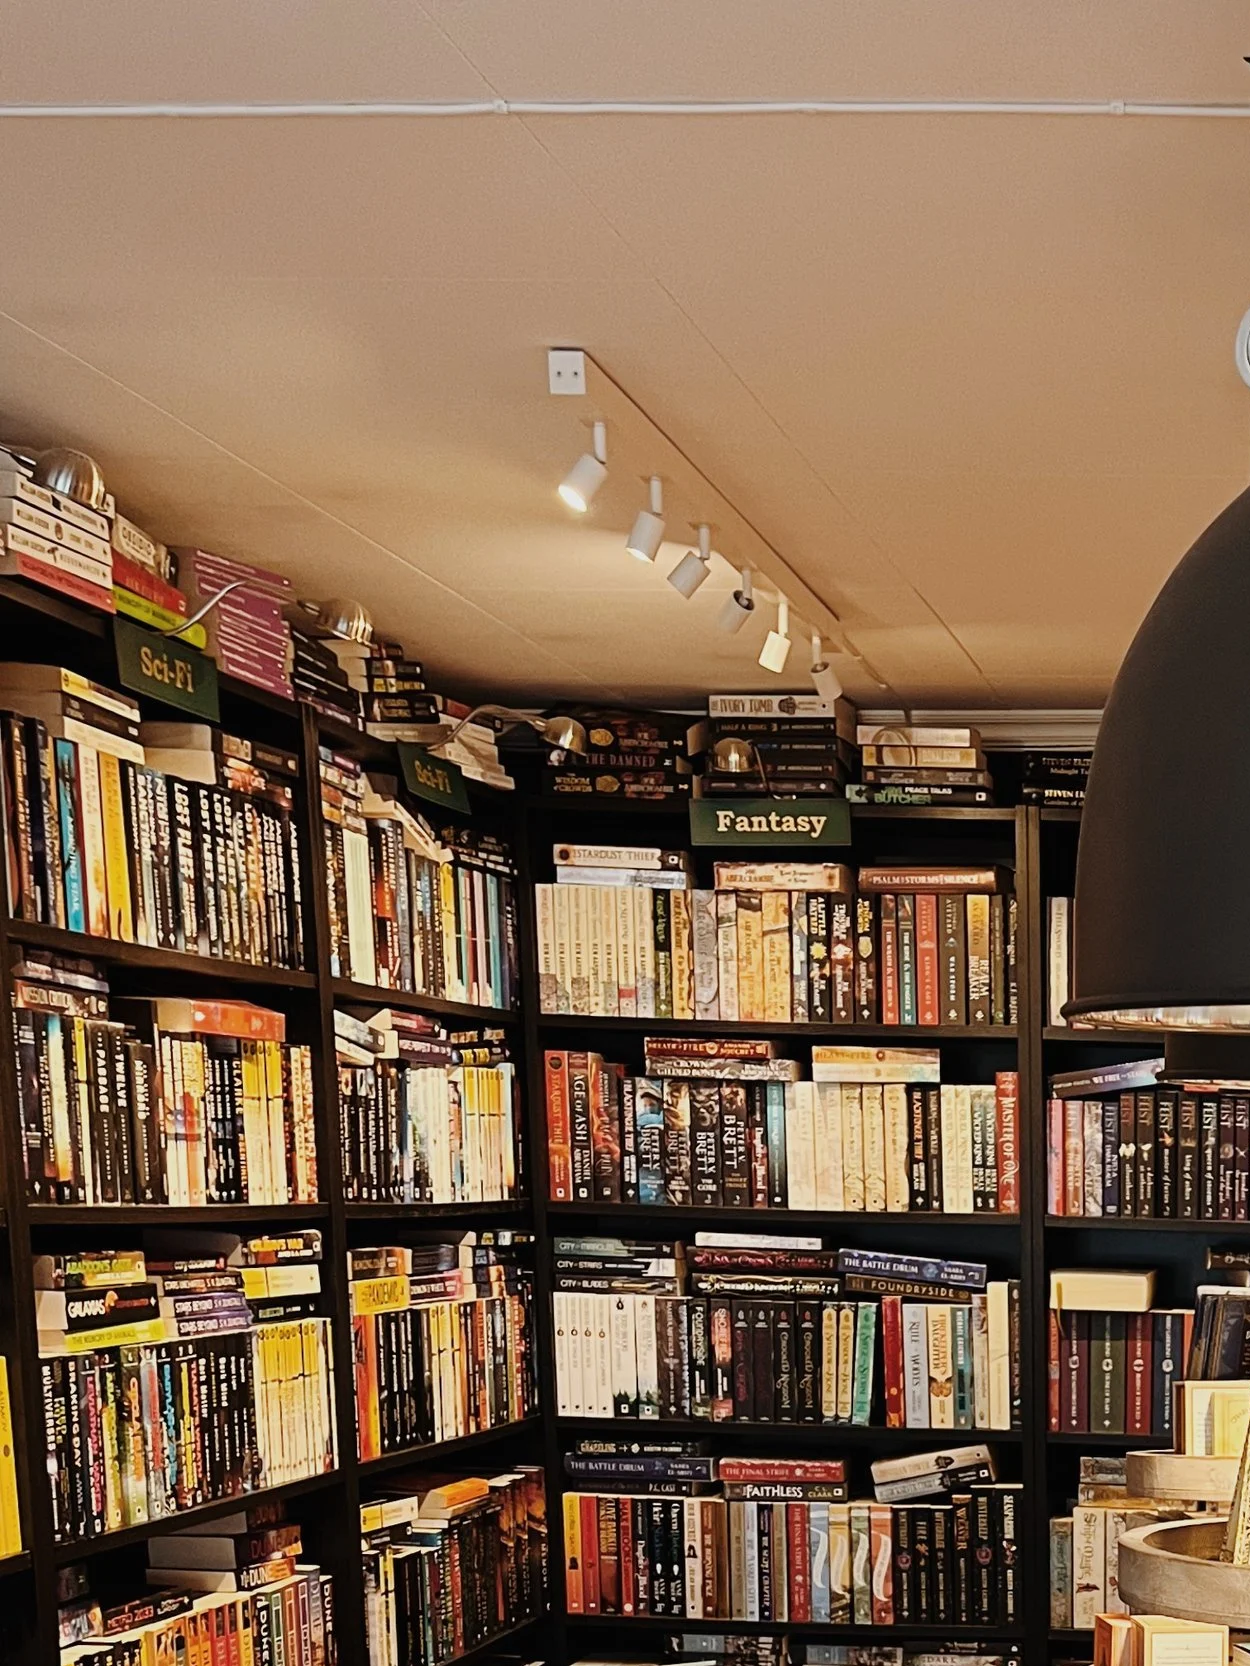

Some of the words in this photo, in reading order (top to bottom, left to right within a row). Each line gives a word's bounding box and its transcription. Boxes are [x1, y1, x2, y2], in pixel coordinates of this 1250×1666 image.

[139, 646, 194, 693] Sci-Fi
[609, 754, 655, 768] DAMNED
[716, 810, 827, 838] Fantasy
[573, 1073, 586, 1100] AGE
[575, 1114, 588, 1141] ASH
[724, 1114, 738, 1169] BRETT
[557, 1261, 573, 1269] CITY
[844, 1257, 860, 1267] THE
[862, 1258, 891, 1271] BATTLE
[893, 1262, 919, 1274] DRUM
[560, 1280, 577, 1288] CITY
[870, 1281, 954, 1298] FOUNDRYSIDE
[571, 1461, 586, 1471] THE
[588, 1462, 617, 1471] BATTLE
[619, 1463, 645, 1472] DRUM
[744, 1484, 803, 1498] FAITHLESS
